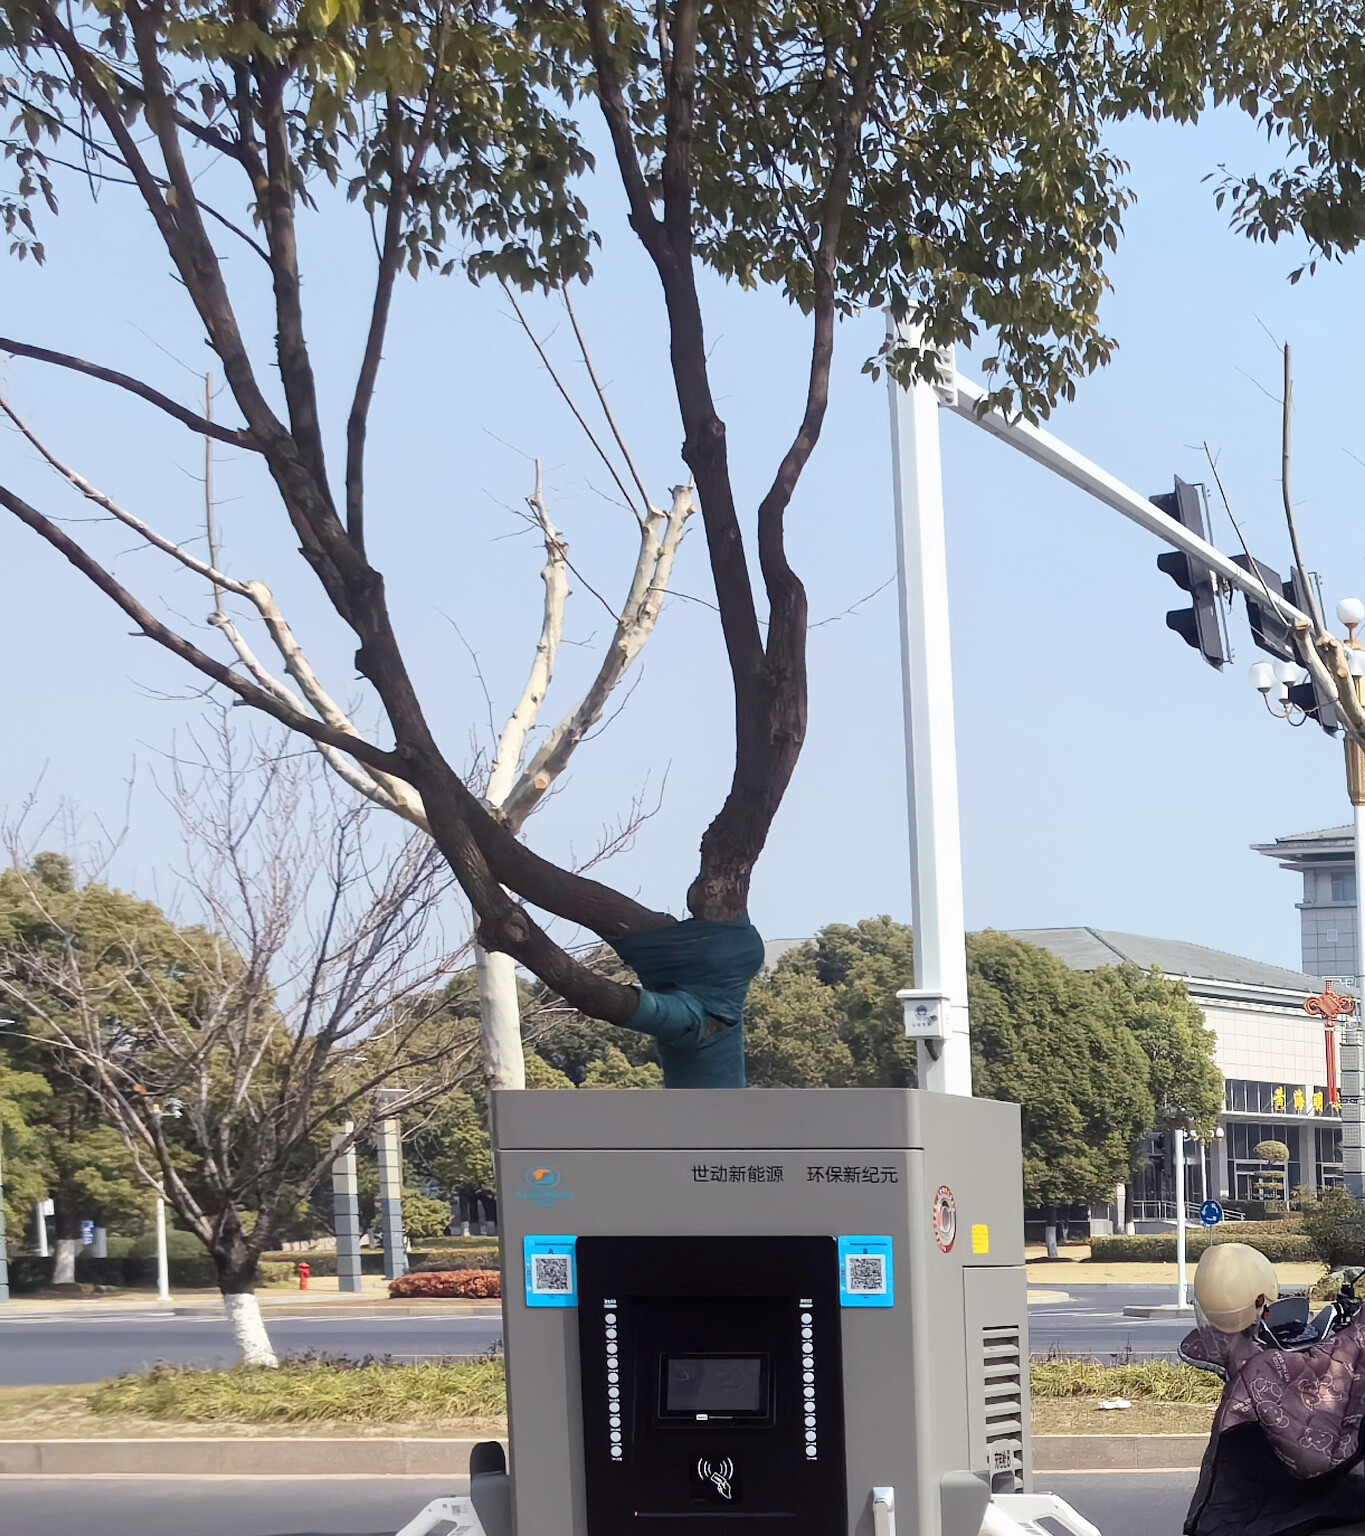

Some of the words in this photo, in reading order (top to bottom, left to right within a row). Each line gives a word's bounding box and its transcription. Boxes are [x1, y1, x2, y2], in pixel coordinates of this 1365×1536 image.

[691, 1165, 785, 1183] 世动新能源
[806, 1165, 899, 1185] 环保新纪元
